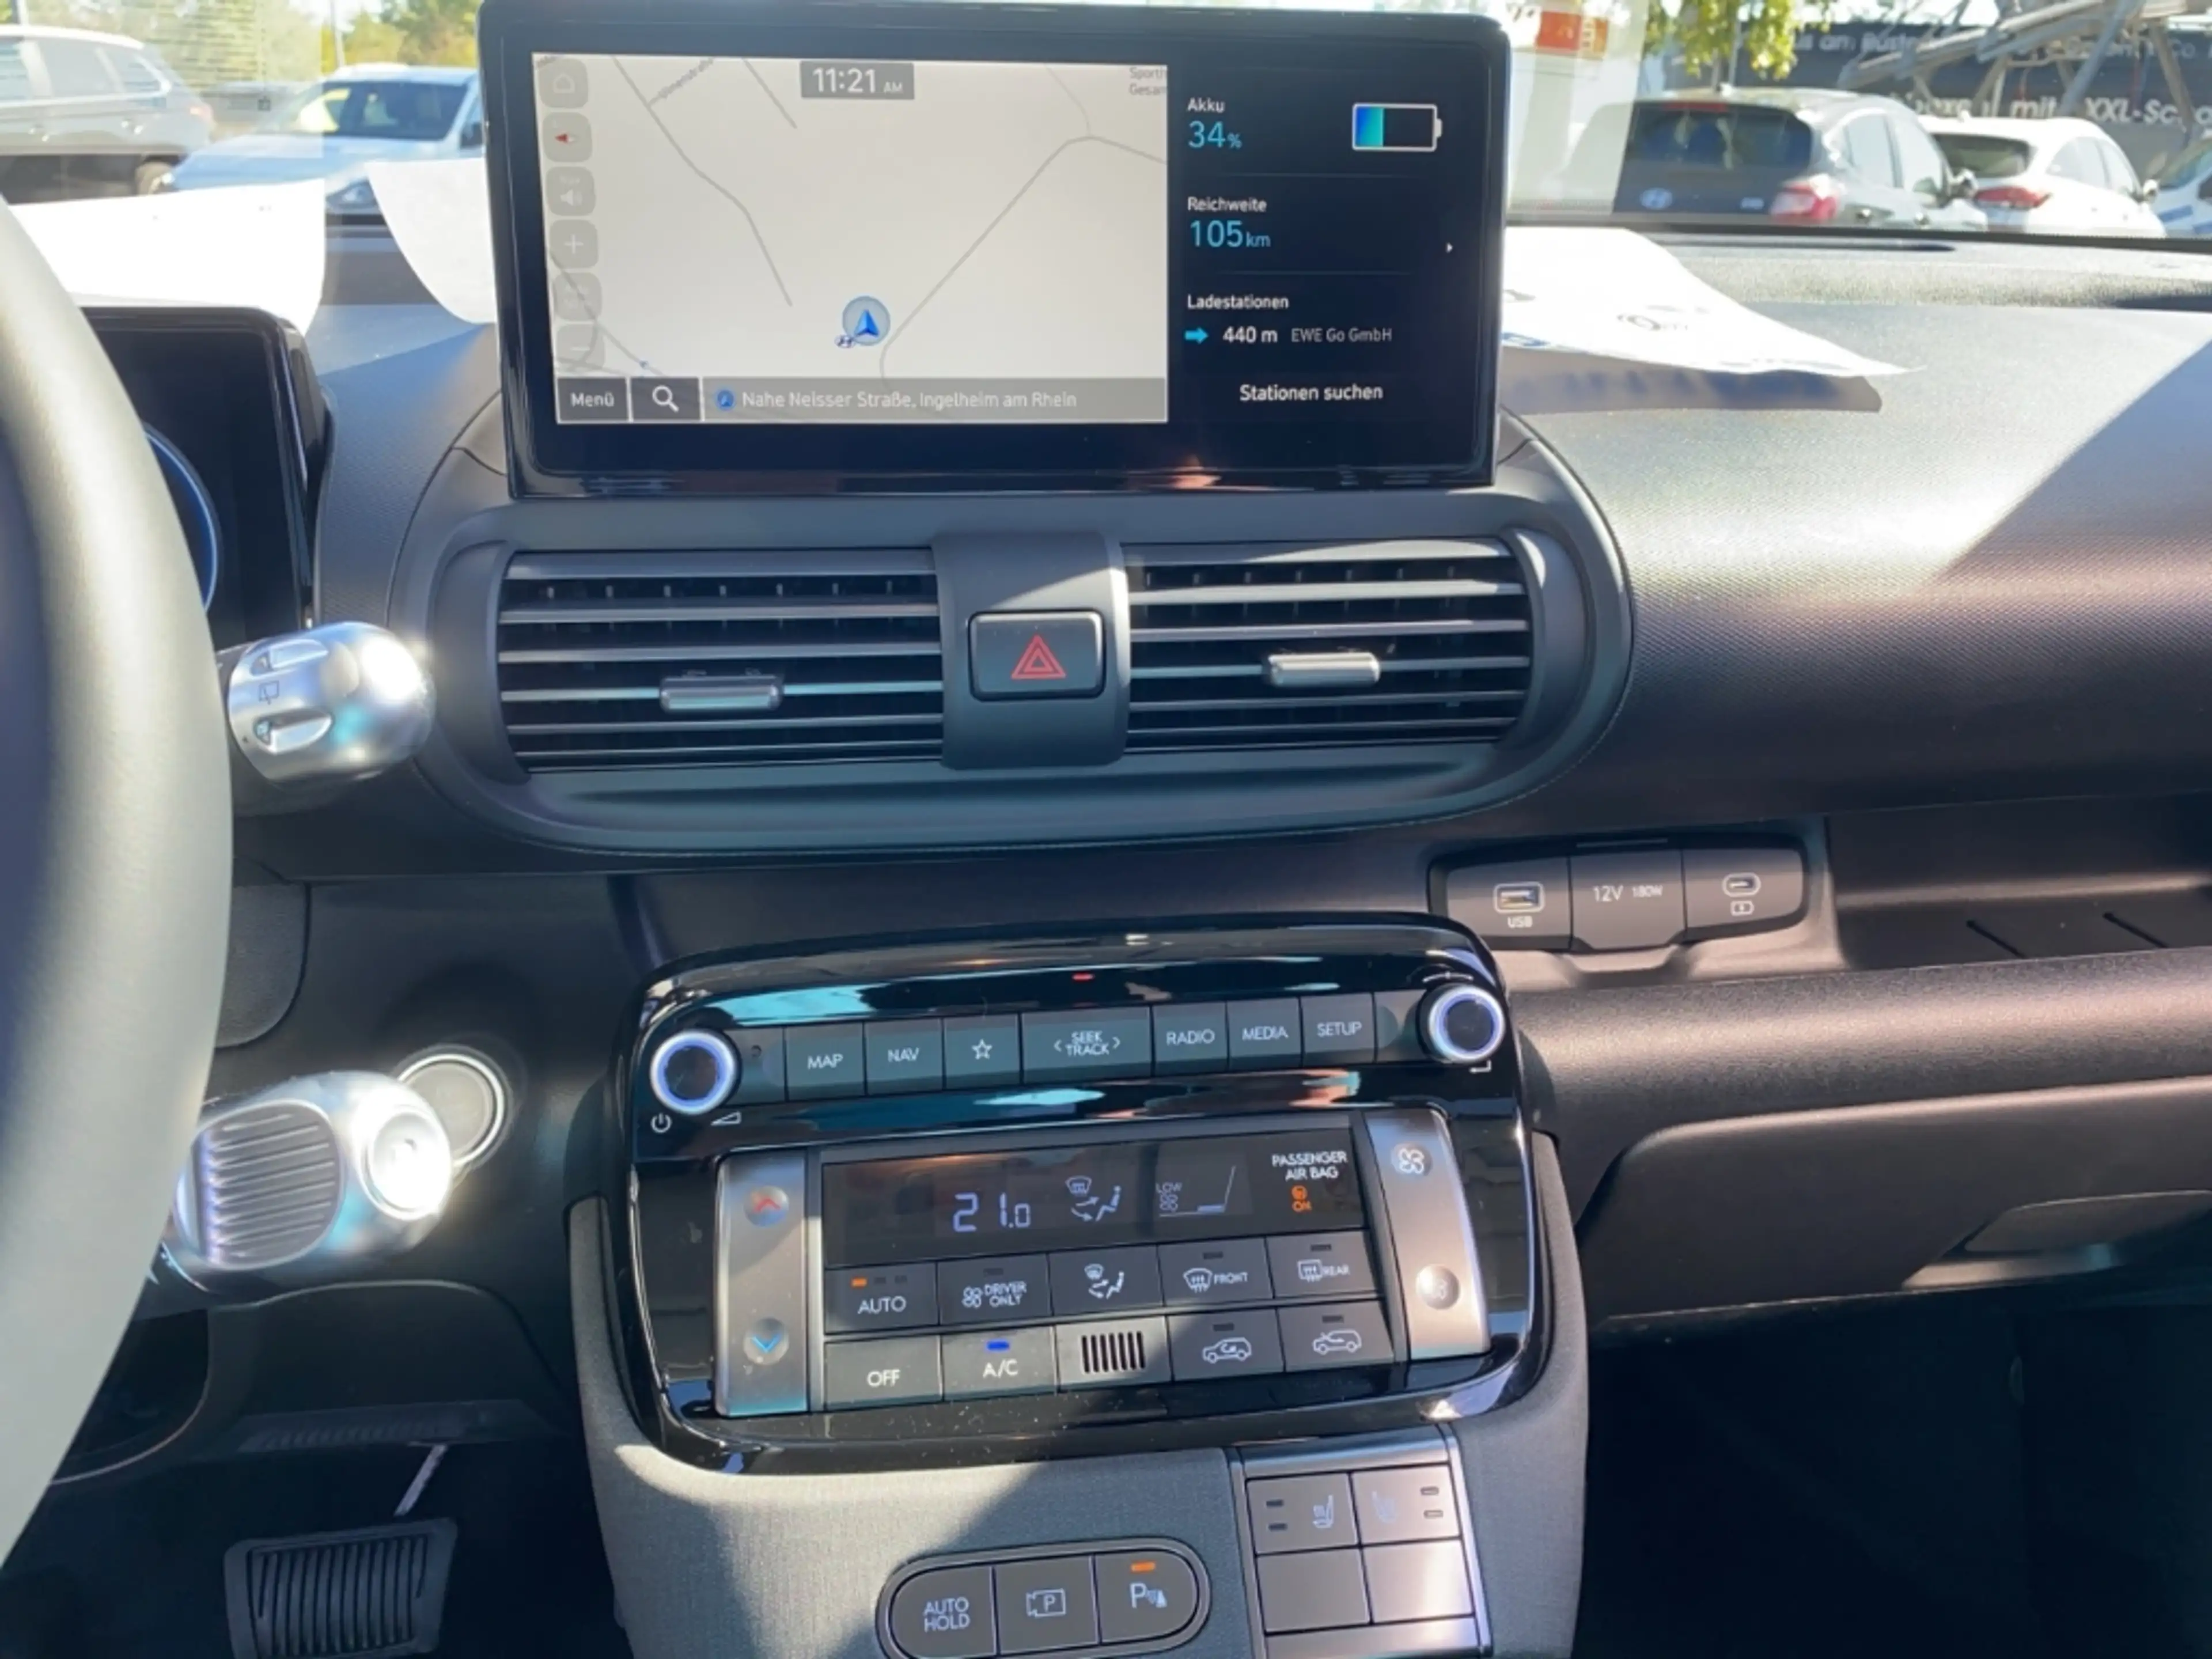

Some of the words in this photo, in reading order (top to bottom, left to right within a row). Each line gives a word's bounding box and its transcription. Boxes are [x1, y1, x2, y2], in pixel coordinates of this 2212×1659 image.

[813, 67, 876, 93] 11:21
[883, 81, 904, 93] AM
[1187, 98, 1225, 112] Akku
[1188, 120, 1242, 149] 34%
[1187, 197, 1267, 212] Reichweite
[1187, 295, 1289, 309] Ladestationen
[1223, 327, 1256, 343] 440
[1261, 330, 1278, 343] m
[1291, 328, 1323, 342] EWE
[1326, 328, 1345, 343] Go
[1349, 328, 1393, 343] GmbH
[570, 392, 615, 407] Menü
[1240, 384, 1318, 401] Stationen
[1324, 384, 1383, 401] suchen
[742, 392, 785, 407] Nahe
[857, 391, 917, 408] Straße,
[920, 392, 999, 411] Ingelheim
[1002, 395, 1027, 407] am
[1031, 392, 1077, 407] Rhein
[1593, 885, 1623, 902] 12V
[1508, 916, 1533, 928] USB
[1071, 1031, 1103, 1043] SEEK
[1242, 1027, 1289, 1041] MEDIA
[1317, 1021, 1363, 1037] SETUP
[1165, 1029, 1215, 1046] RADIO
[887, 1048, 919, 1063] NAV
[1066, 1043, 1110, 1057] TRACK
[808, 1054, 843, 1070] MAP
[1271, 1151, 1348, 1167] PASSENGER
[1285, 1167, 1308, 1181] AIR
[1311, 1166, 1339, 1179] BAG
[952, 1192, 1031, 1232] 21.0
[1213, 1272, 1248, 1285] FRONT
[984, 1281, 1027, 1295] DRIVER
[858, 1297, 907, 1315] AUTO
[989, 1294, 1022, 1308] ONLY
[983, 1359, 1018, 1378] A/C
[867, 1369, 900, 1387] OFF
[924, 1597, 969, 1615] AUTO
[924, 1613, 969, 1631] HOLD
